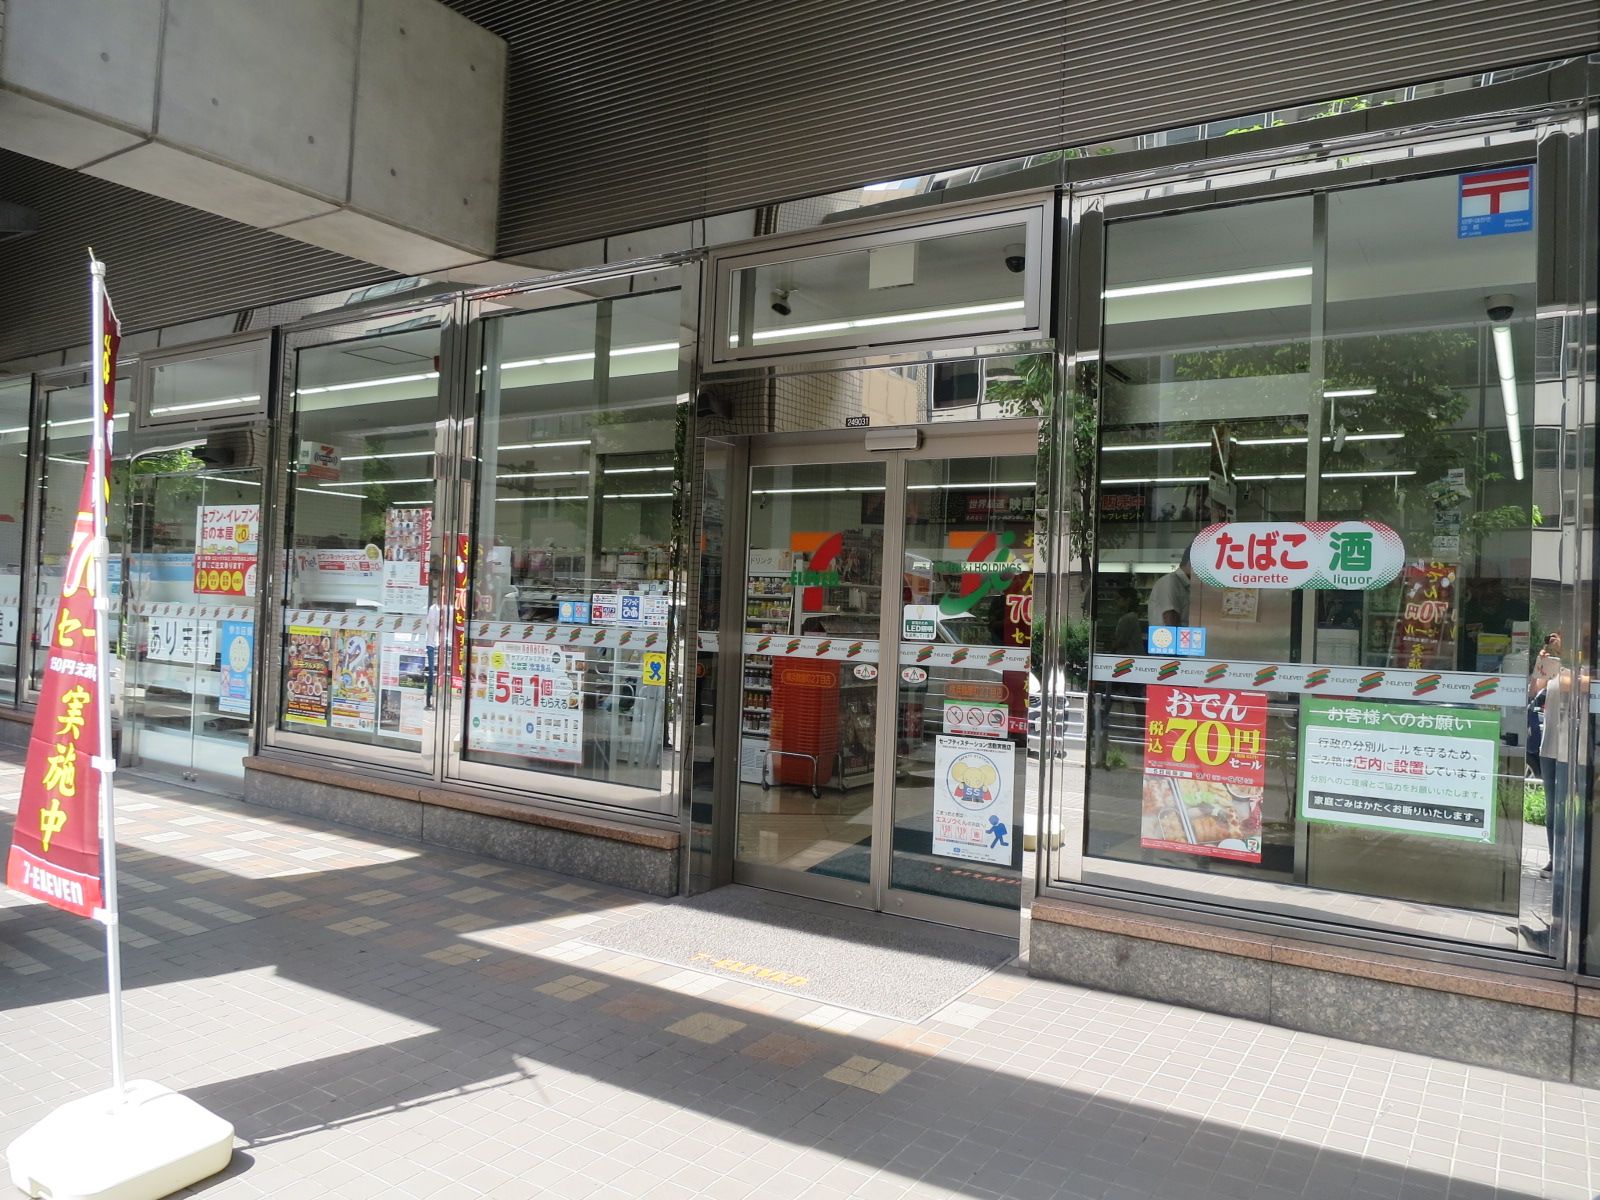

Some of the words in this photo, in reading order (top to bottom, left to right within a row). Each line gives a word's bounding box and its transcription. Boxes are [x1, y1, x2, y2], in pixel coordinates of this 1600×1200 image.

[847, 418, 869, 427] 249031
[1215, 531, 1309, 572] たばこ
[1329, 531, 1374, 572] 酒
[1232, 573, 1289, 585] cigarette
[1332, 574, 1373, 587] liquor
[623, 607, 639, 618] ぴあ
[150, 620, 212, 657] あります
[511, 695, 532, 706] 買うと
[540, 698, 568, 710] もらえる
[1165, 688, 1249, 722] おでん
[1327, 706, 1472, 731] お客様へのお願い
[939, 738, 1012, 751] セーフティステーション活動実施店
[1148, 720, 1165, 753] 税込
[1165, 717, 1262, 766] 70円
[1318, 737, 1479, 761] 行政の分別ルールを守るため、
[40, 685, 91, 852] 実施中
[1229, 757, 1263, 771] セール
[1310, 754, 1487, 781] ごみ箱は店内に設置しています。
[966, 787, 980, 796] SS
[1313, 795, 1480, 823] 家庭ごみはかたくお断りいたします。
